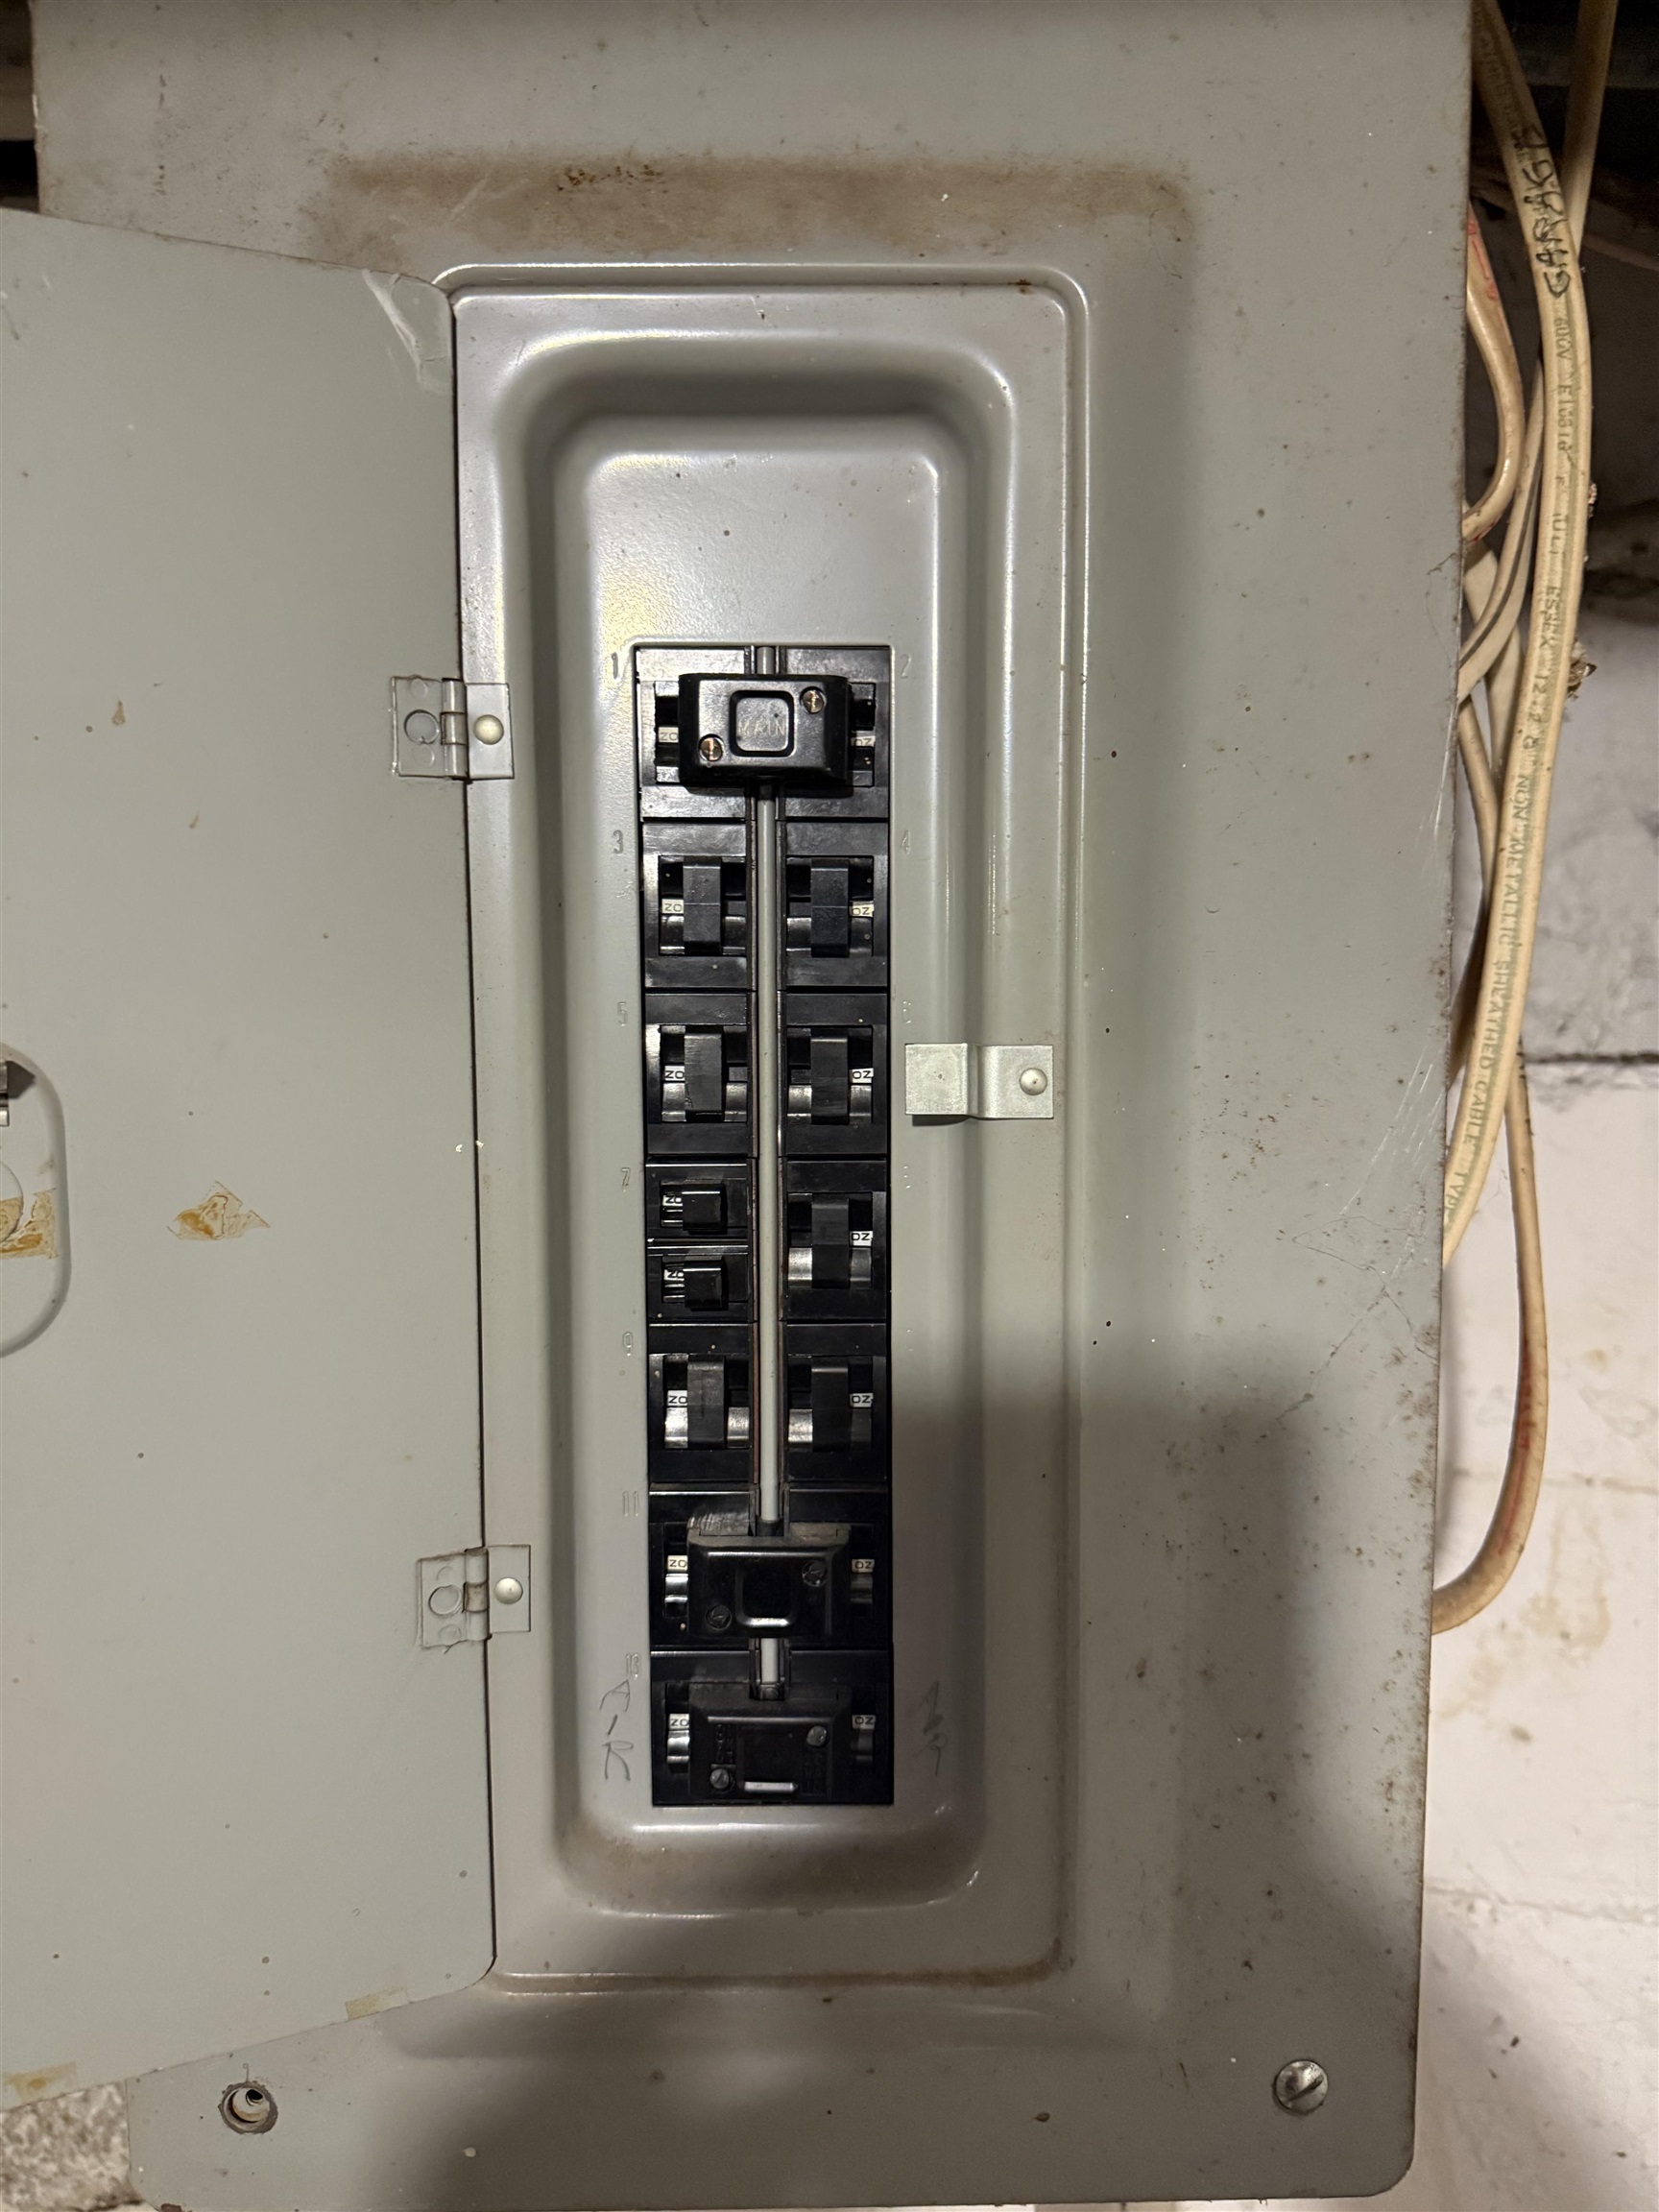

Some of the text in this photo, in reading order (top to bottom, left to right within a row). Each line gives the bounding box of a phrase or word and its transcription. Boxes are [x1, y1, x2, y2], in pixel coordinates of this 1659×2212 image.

[611, 652, 619, 680] 1
[900, 653, 911, 680] 2
[737, 720, 786, 736] MAIN
[613, 830, 625, 854] 3
[902, 829, 911, 854] 4
[616, 1001, 628, 1027] 5
[1463, 1080, 1488, 1146] CABLE
[621, 1166, 632, 1192] 7
[622, 1331, 634, 1358] 9
[621, 1490, 639, 1519] 11
[625, 1653, 640, 1681] 13
